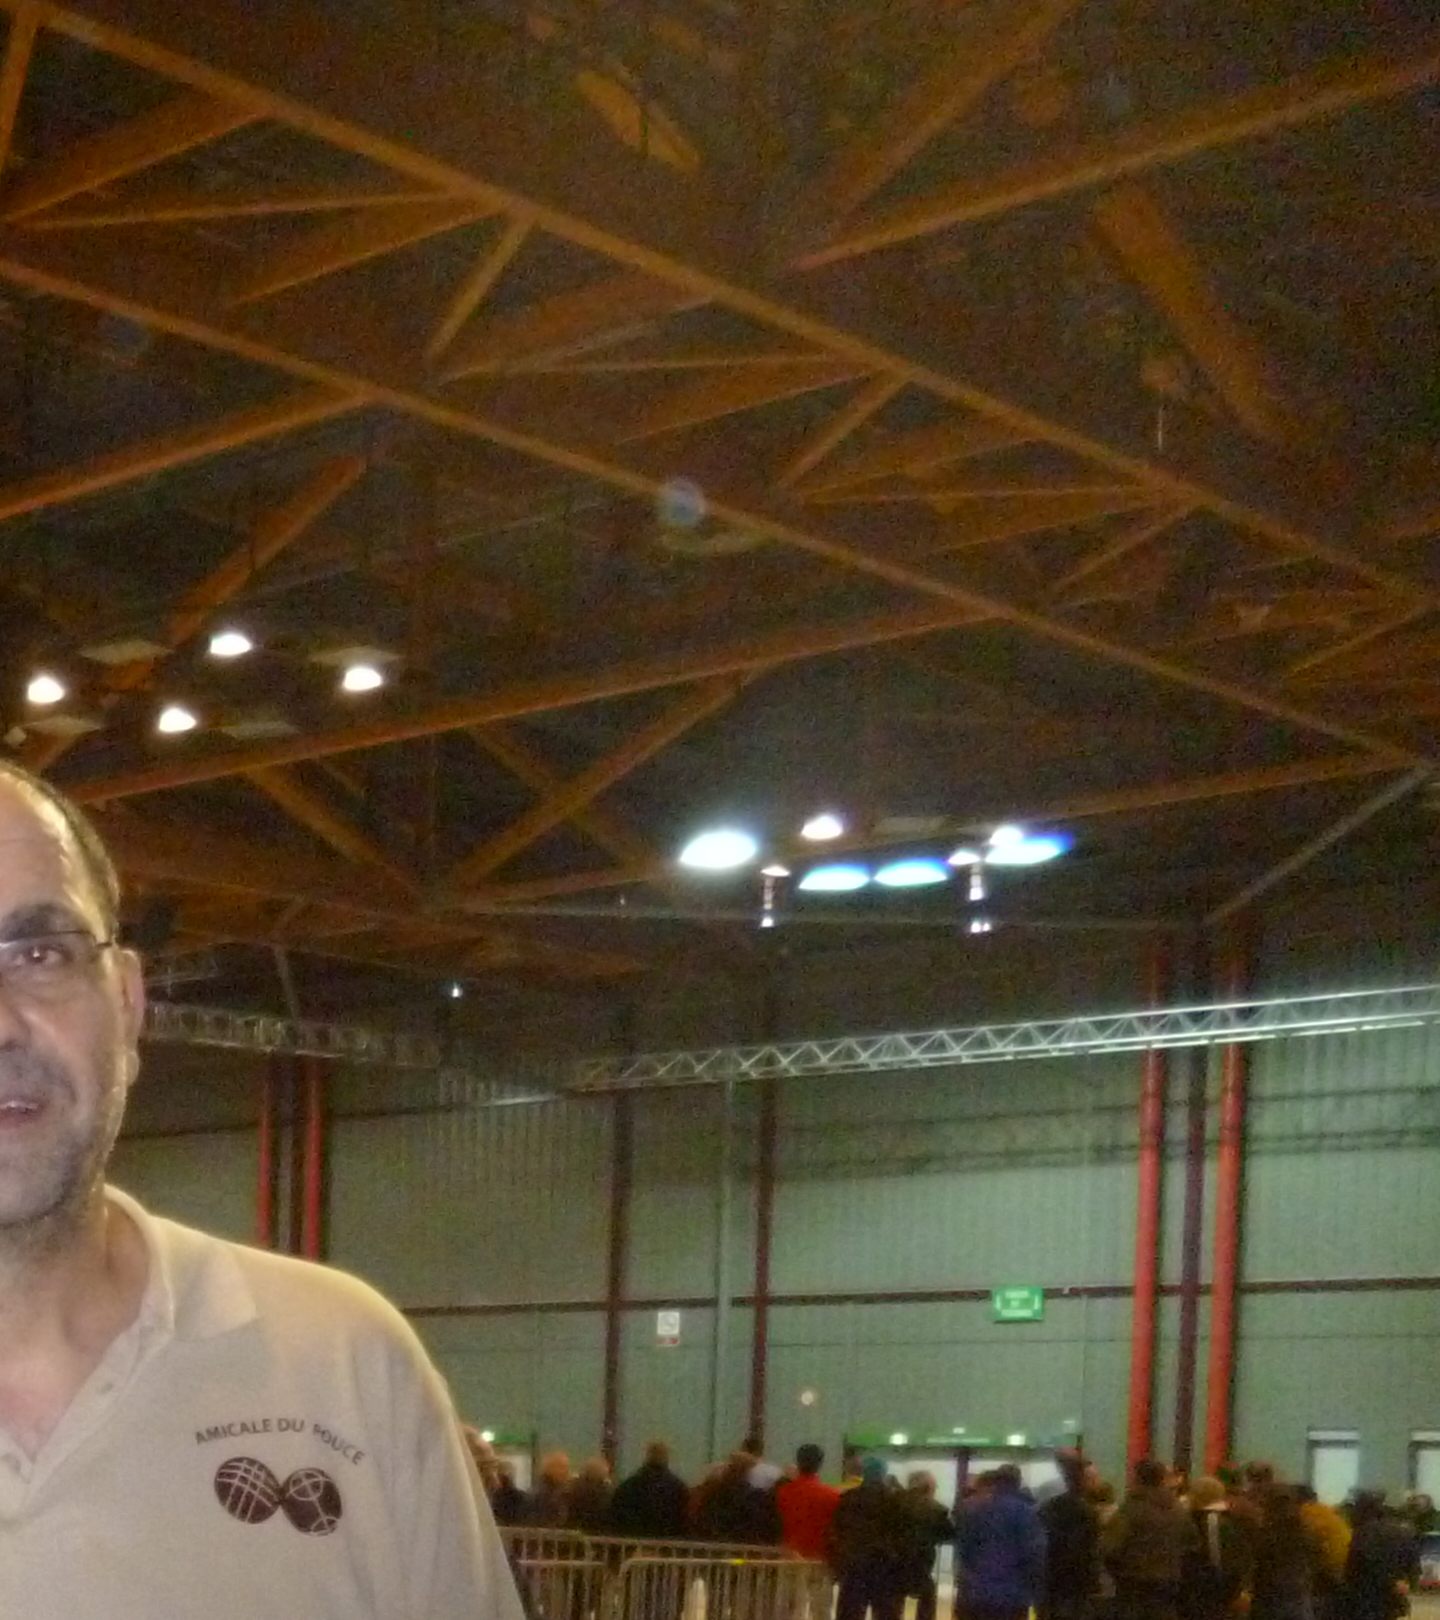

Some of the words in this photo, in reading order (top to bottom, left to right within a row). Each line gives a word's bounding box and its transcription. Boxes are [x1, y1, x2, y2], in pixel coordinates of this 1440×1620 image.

[194, 1418, 272, 1445] AMICALE
[277, 1417, 305, 1432] DU
[312, 1423, 365, 1466] POUCE
